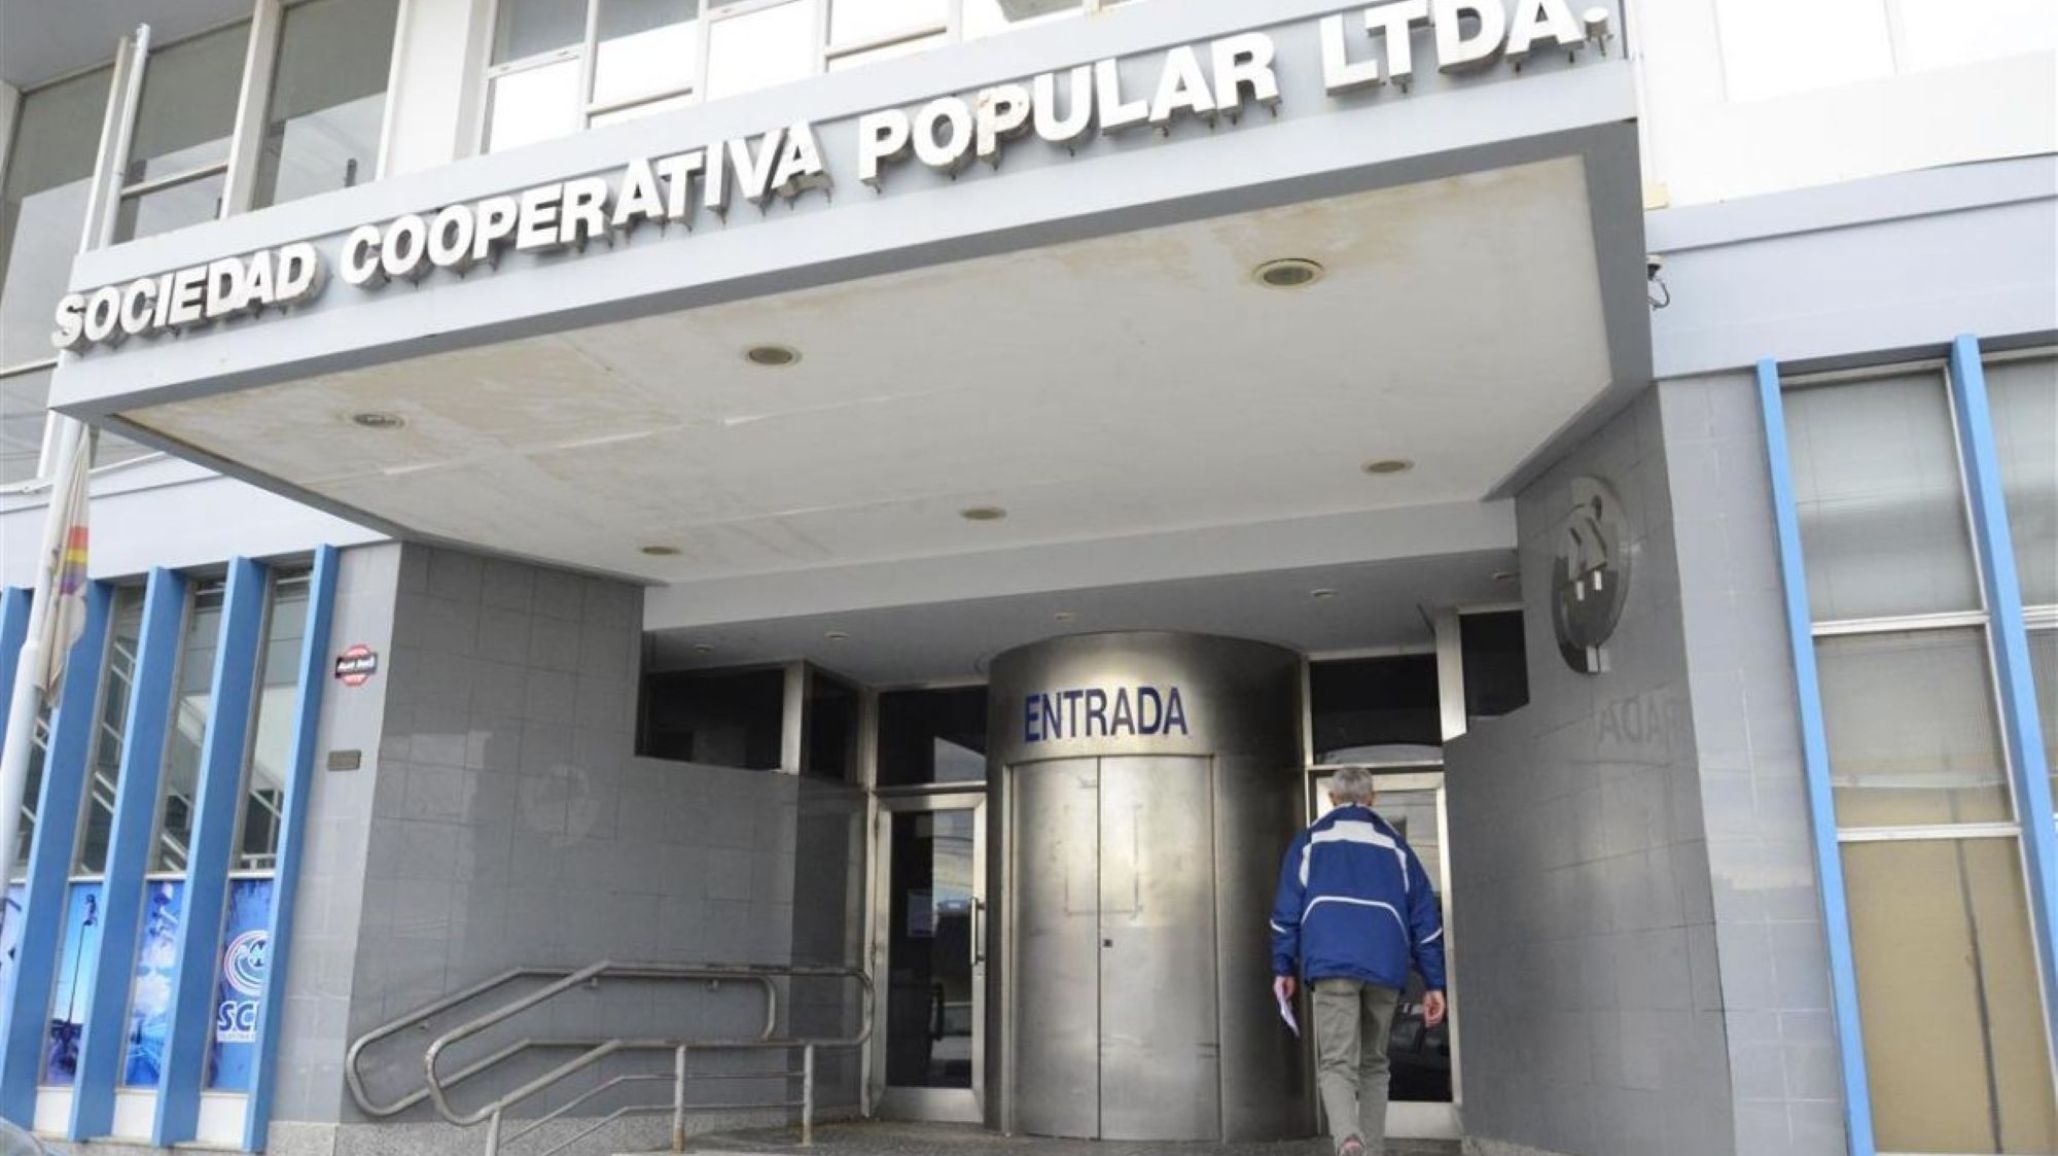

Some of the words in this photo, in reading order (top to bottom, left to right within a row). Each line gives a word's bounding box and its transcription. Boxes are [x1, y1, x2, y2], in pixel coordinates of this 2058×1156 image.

[51, 241, 317, 348] SOCIEDAD
[339, 120, 823, 285] COOPERATIVA
[857, 31, 1279, 182] POPULAR
[1320, 0, 1609, 89] LTDA.
[1024, 687, 1188, 743] ENTRADA
[217, 1001, 259, 1032] SC
